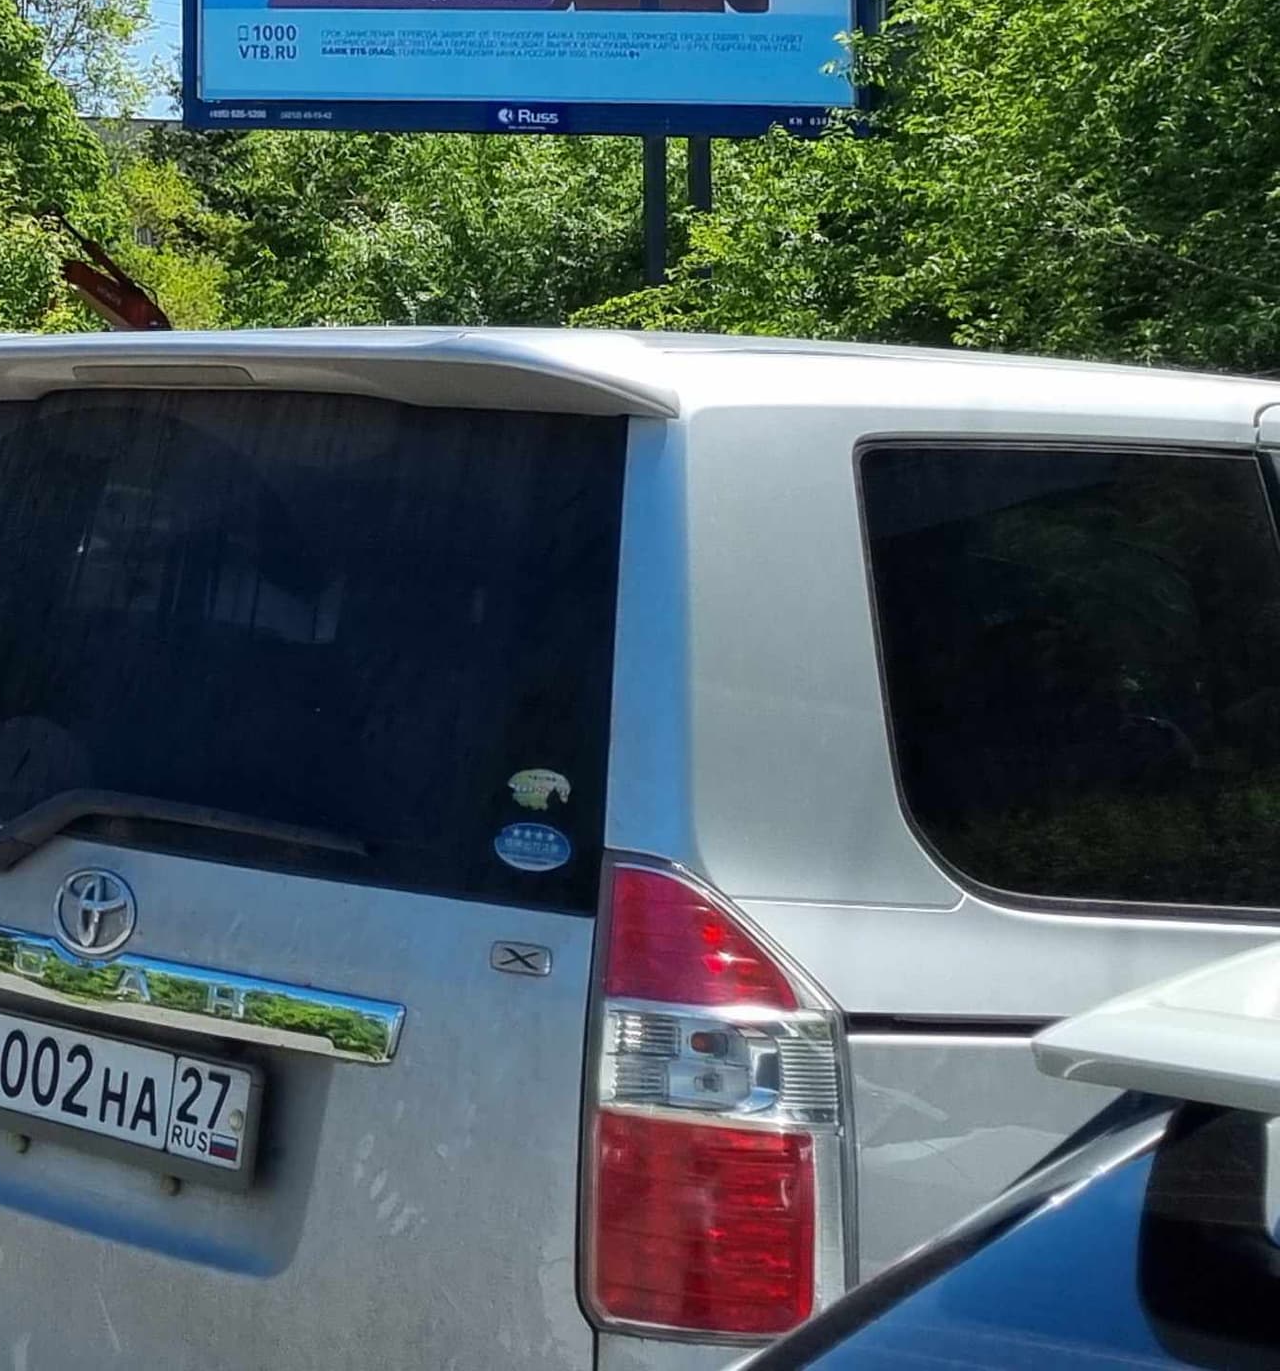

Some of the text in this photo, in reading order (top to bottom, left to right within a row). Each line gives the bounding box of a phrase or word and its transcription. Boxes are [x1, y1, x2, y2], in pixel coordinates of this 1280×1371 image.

[252, 25, 297, 41] 1000
[239, 44, 297, 59] VTB.RU
[518, 108, 559, 123] Russ
[176, 1067, 232, 1129] 27
[171, 1125, 208, 1152] RUS
